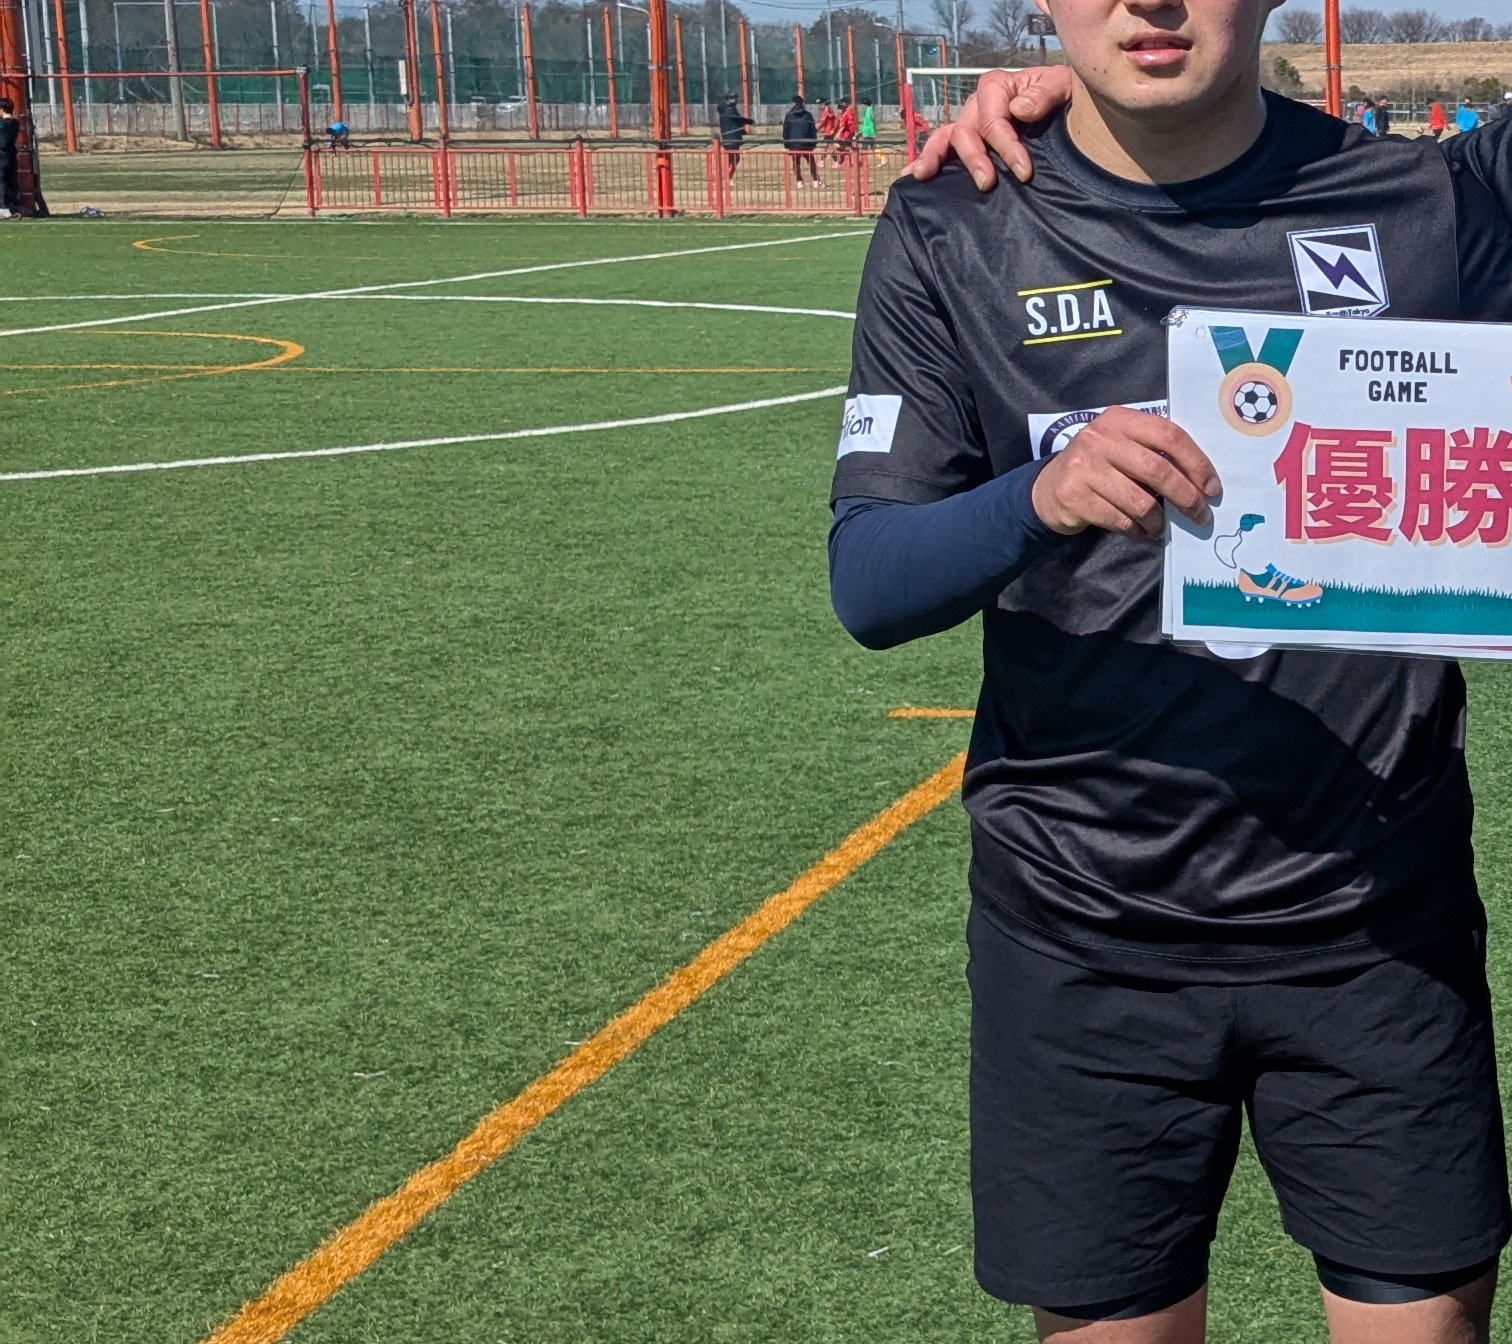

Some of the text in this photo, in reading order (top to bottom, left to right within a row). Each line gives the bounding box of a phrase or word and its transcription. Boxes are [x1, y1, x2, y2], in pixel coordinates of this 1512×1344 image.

[1025, 289, 1116, 336] S.D.A
[1339, 349, 1458, 374] FOOTBALL
[1368, 380, 1428, 403] GAME
